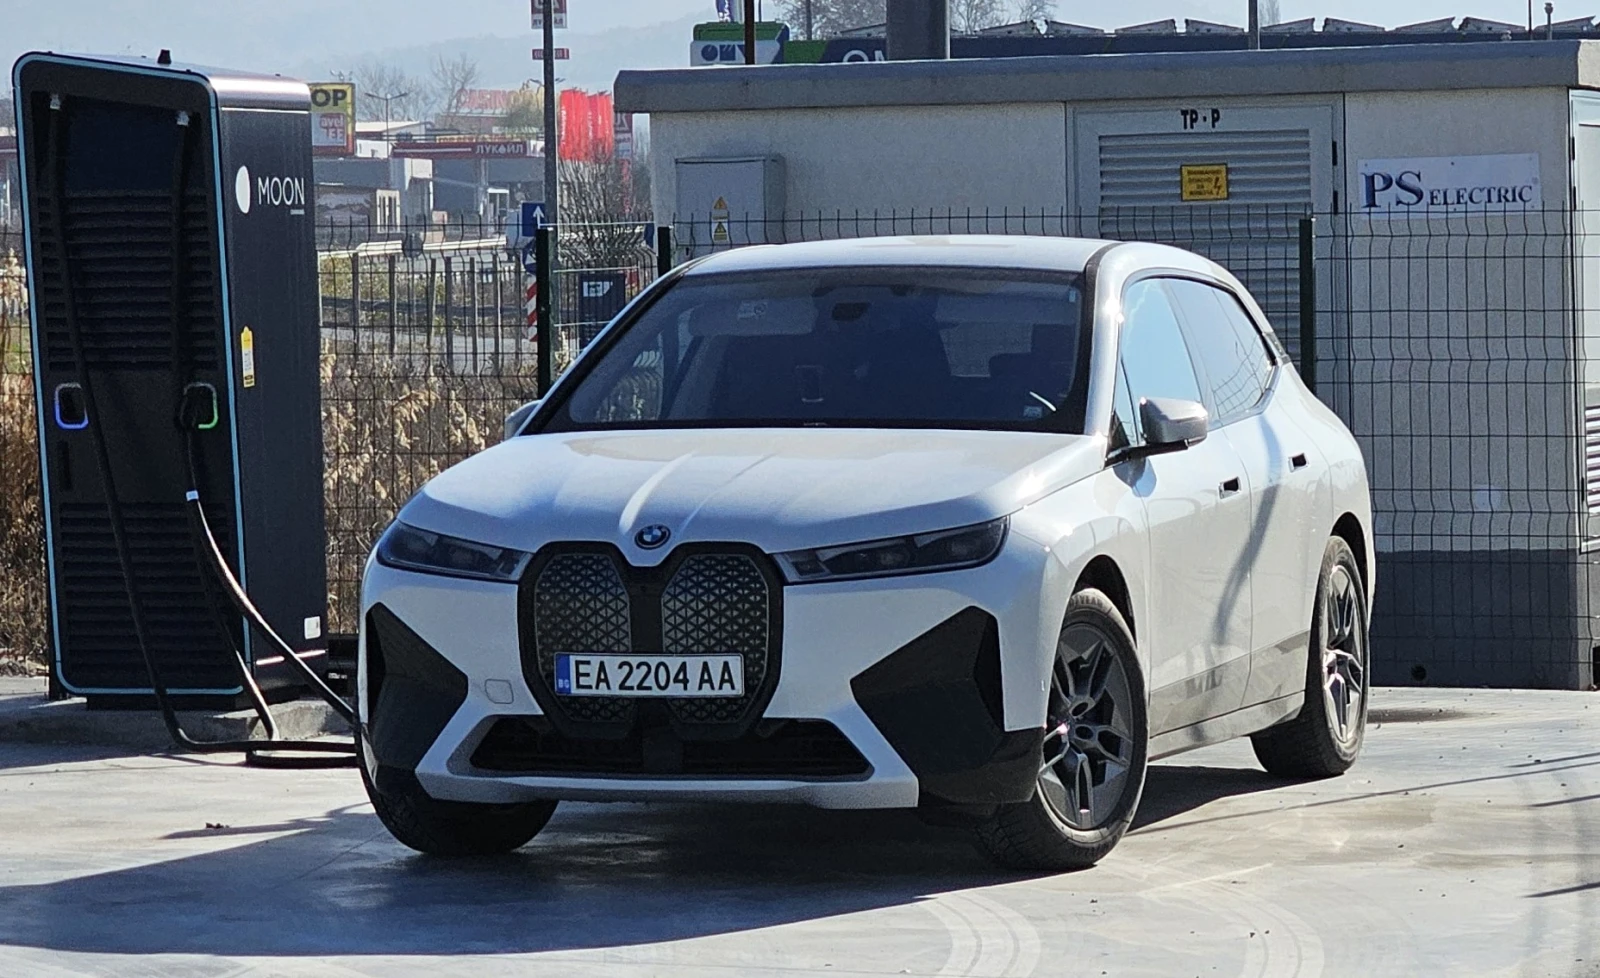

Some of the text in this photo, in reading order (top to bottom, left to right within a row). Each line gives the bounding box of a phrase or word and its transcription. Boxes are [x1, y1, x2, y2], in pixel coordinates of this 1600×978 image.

[257, 176, 305, 206] MOON
[1361, 170, 1533, 209] PS ELECTRIC
[574, 660, 736, 691] EA 2204 AA
